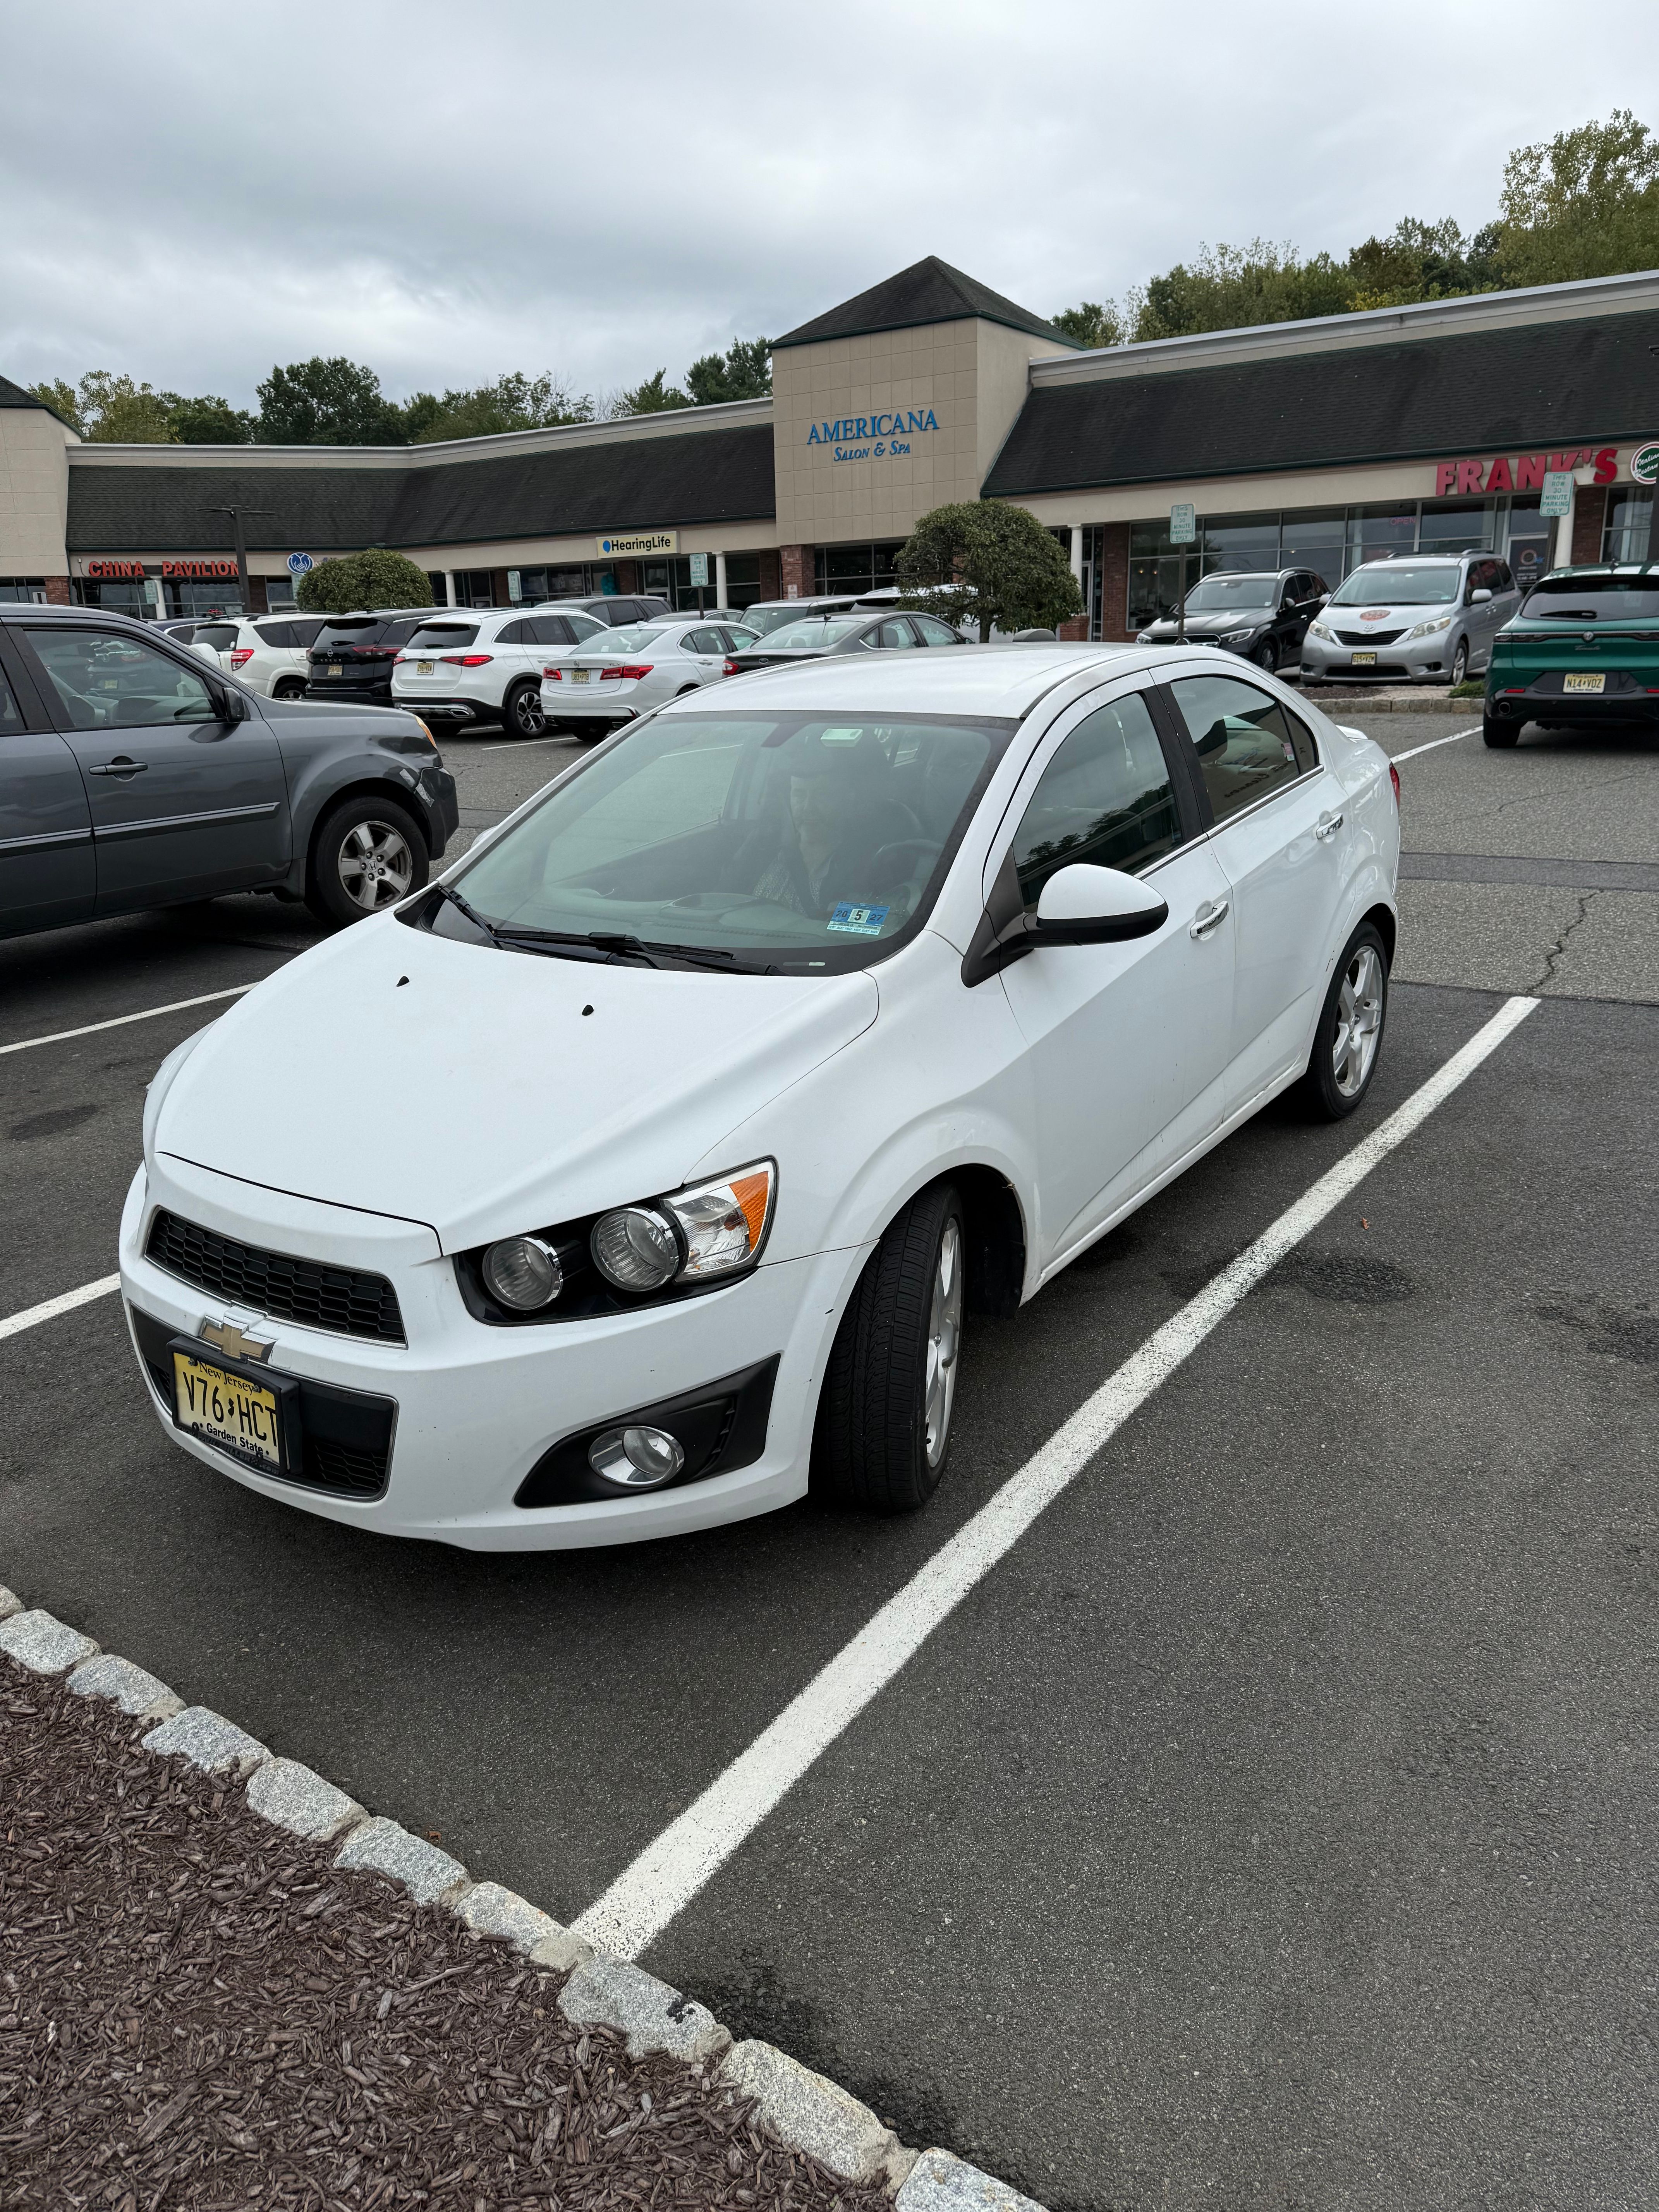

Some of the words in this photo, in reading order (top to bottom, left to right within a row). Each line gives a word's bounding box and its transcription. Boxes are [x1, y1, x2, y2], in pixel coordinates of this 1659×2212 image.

[807, 409, 939, 445] AMERICANA
[873, 442, 886, 457] &
[1436, 448, 1618, 496] FRANK'S
[1390, 517, 1416, 525] OPEN
[611, 536, 671, 551] HearingLife
[89, 561, 145, 577] CHINA
[162, 560, 239, 577] PAVILION
[854, 910, 864, 921] 5
[199, 1361, 221, 1380] New
[223, 1372, 254, 1395] Jersey
[206, 1423, 236, 1444] Garden
[240, 1437, 263, 1453] State
